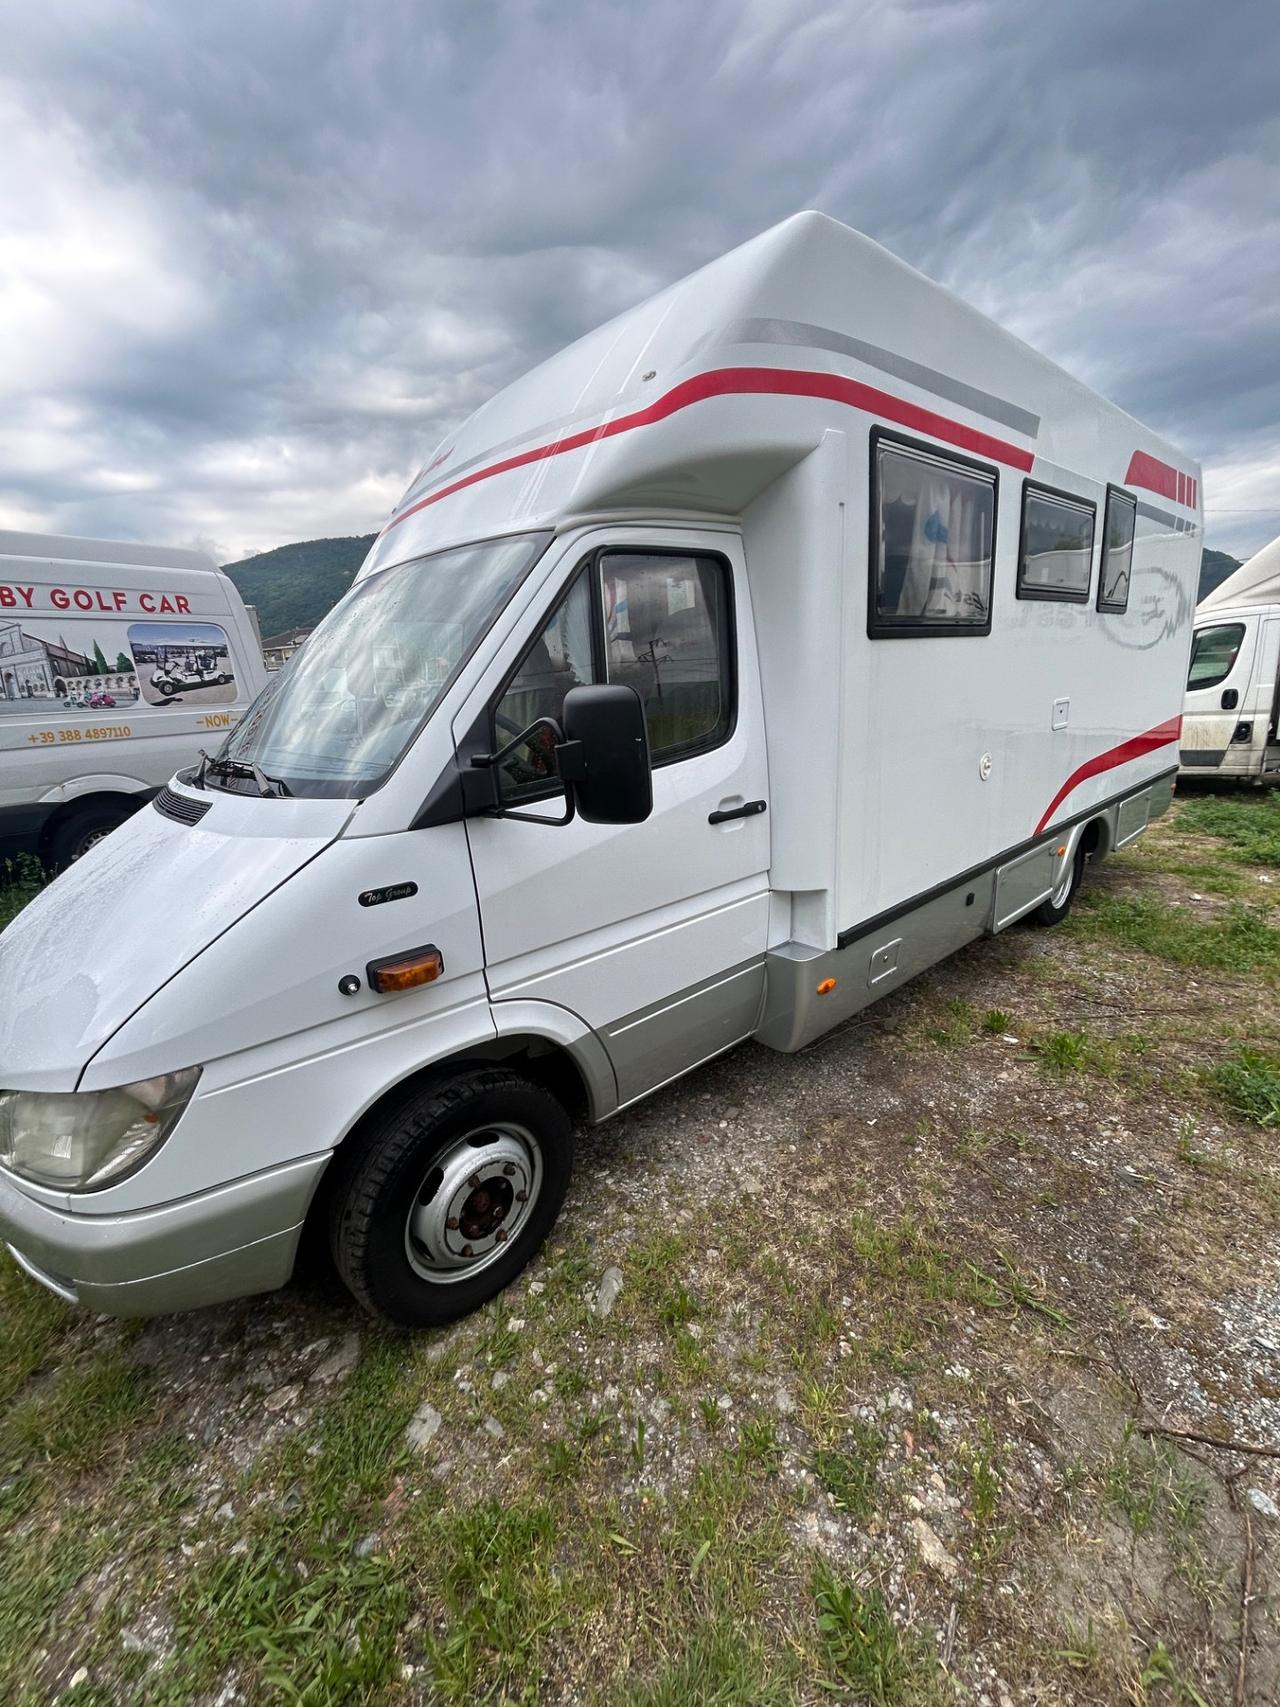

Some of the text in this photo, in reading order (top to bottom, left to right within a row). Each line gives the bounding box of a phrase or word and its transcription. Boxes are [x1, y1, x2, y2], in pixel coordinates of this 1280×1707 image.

[0, 586, 192, 613] BY GOLF CAR
[28, 726, 131, 744] +39 388 4897110
